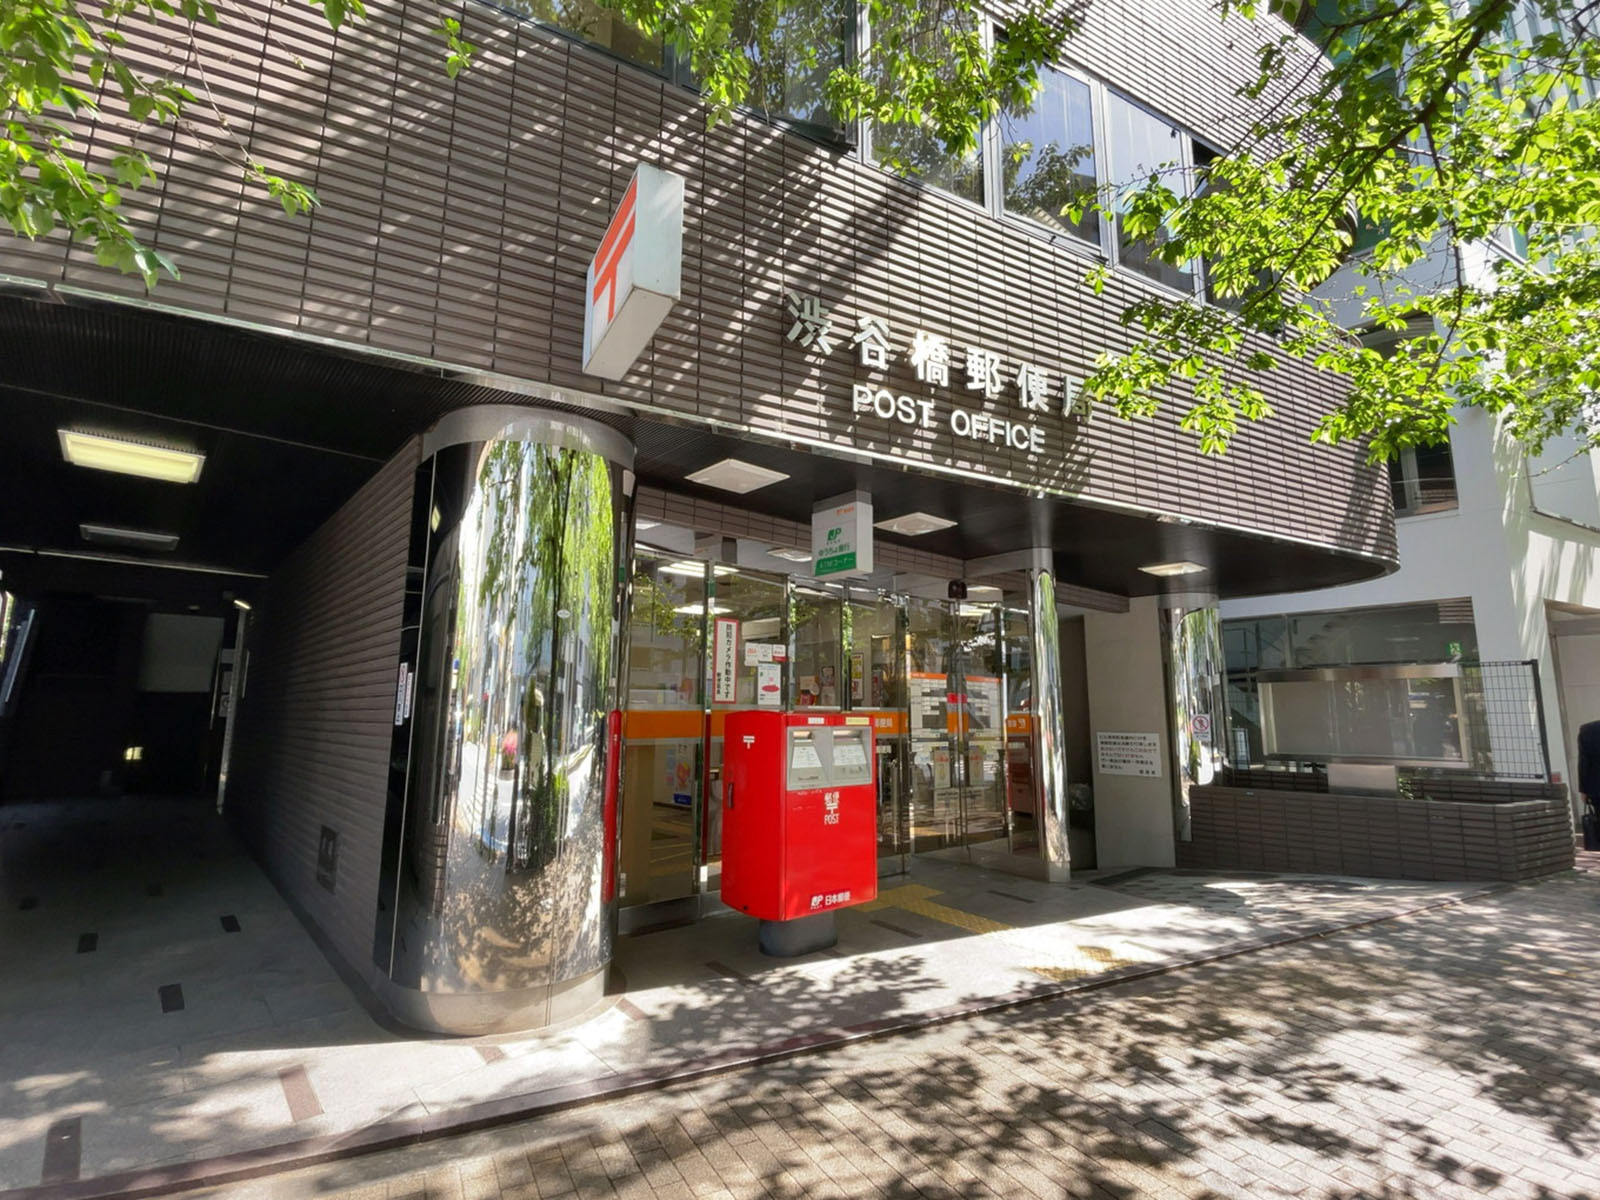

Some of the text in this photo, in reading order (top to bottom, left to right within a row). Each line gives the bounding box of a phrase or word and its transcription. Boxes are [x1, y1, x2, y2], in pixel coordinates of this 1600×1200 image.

[852, 384, 1046, 453] POST OFFICE
[824, 813, 839, 825] POST
[825, 891, 851, 905] 日本郵便
